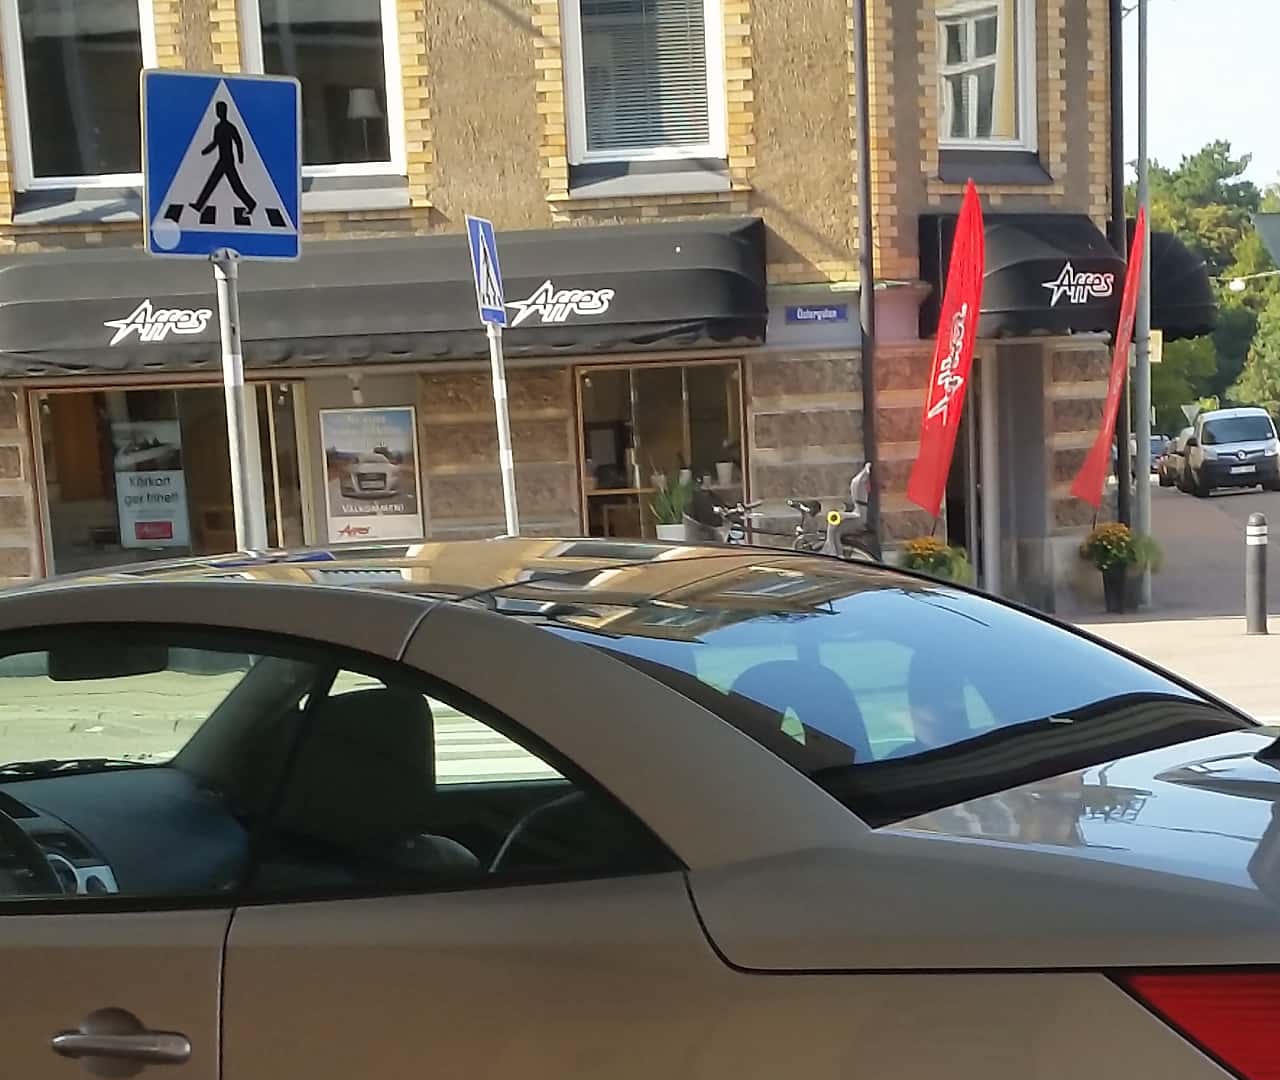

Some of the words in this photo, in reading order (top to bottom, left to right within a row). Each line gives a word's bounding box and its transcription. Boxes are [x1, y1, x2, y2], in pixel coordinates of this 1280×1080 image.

[503, 279, 616, 328] Affes
[1040, 261, 1115, 307] Affes
[103, 298, 213, 347] Affes
